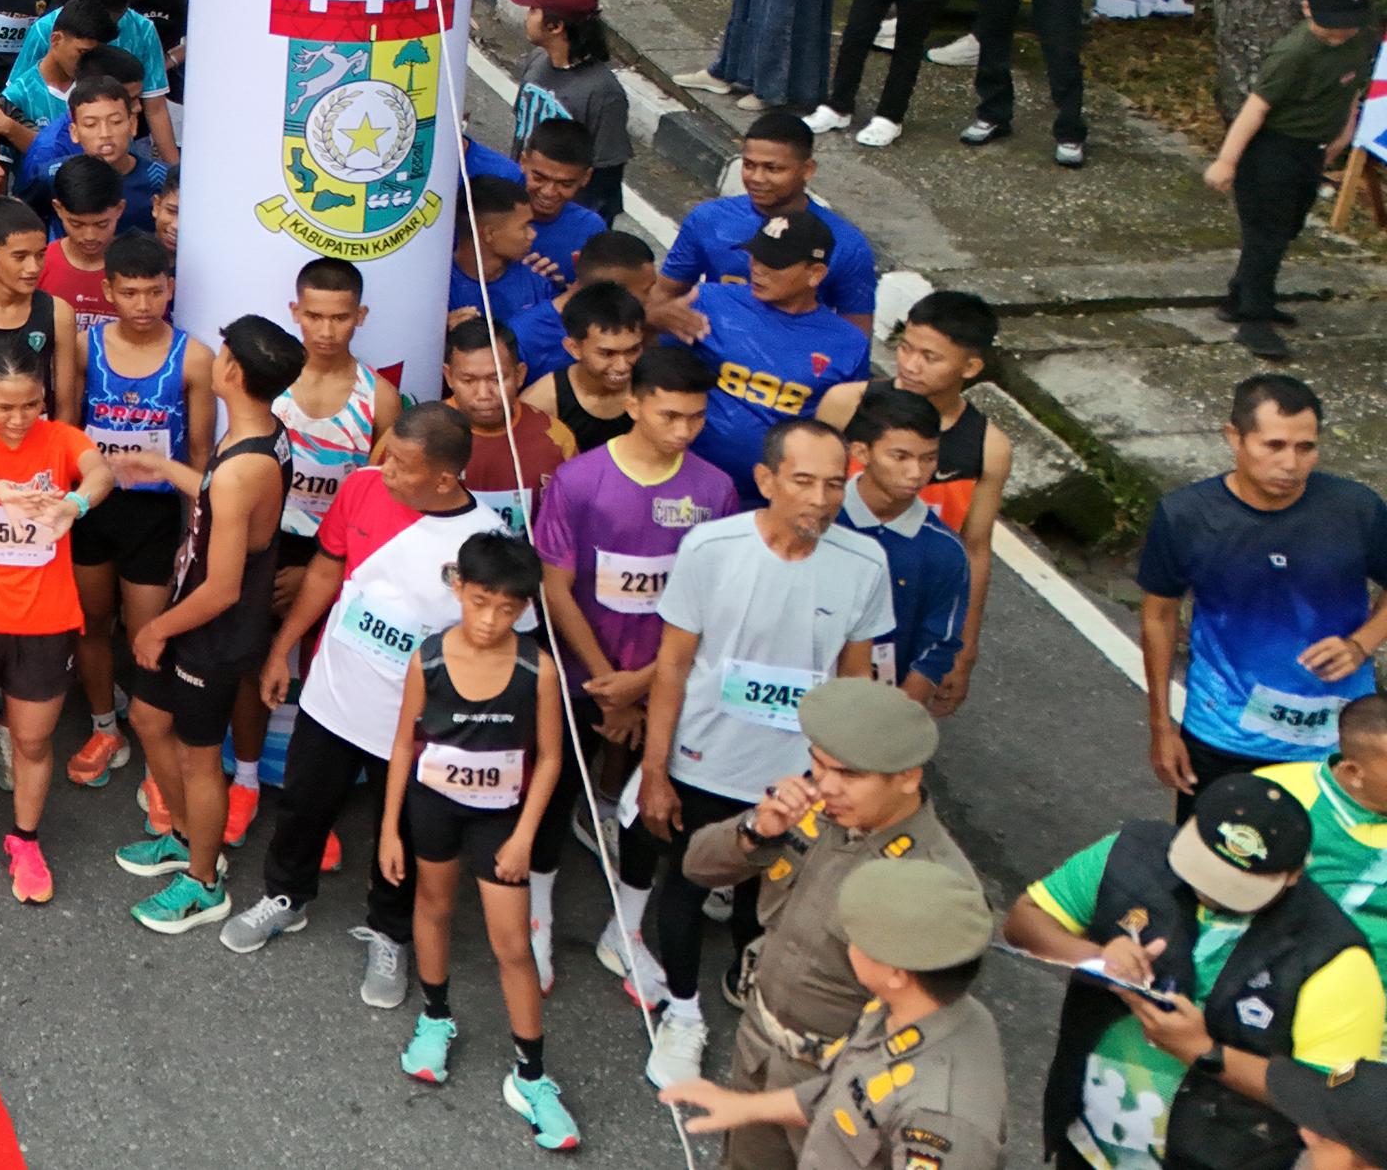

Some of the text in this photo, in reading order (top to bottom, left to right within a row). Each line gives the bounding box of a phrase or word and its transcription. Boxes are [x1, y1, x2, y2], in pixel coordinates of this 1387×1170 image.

[290, 217, 420, 257] KABUPATEN KAMPAR
[718, 361, 813, 414] 898
[293, 472, 338, 496] 2170
[358, 611, 415, 653] 3865
[745, 681, 807, 709] 3245
[445, 764, 501, 787] 2319
